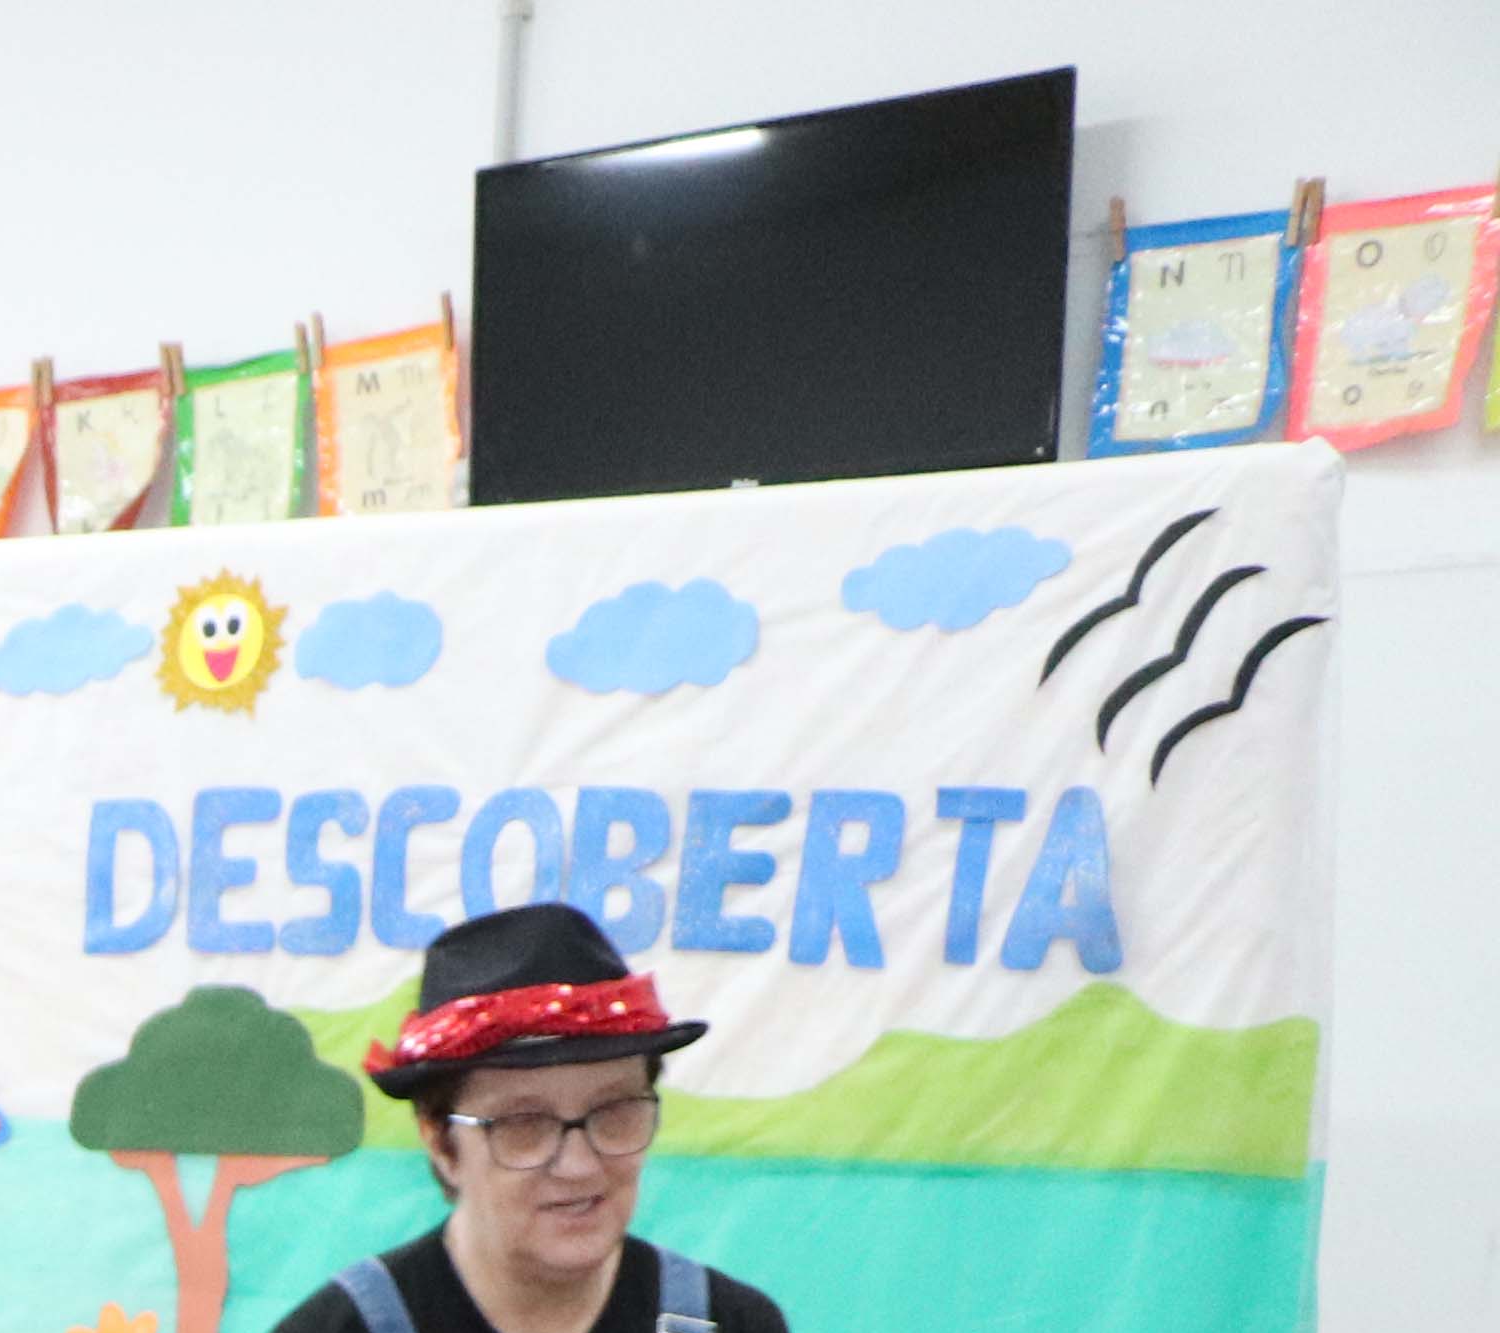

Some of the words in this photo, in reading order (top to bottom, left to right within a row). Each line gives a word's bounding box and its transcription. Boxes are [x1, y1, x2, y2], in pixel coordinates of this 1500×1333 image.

[1160, 260, 1185, 289] N
[356, 372, 380, 396] M
[83, 785, 1123, 973] DESCOBERTA
